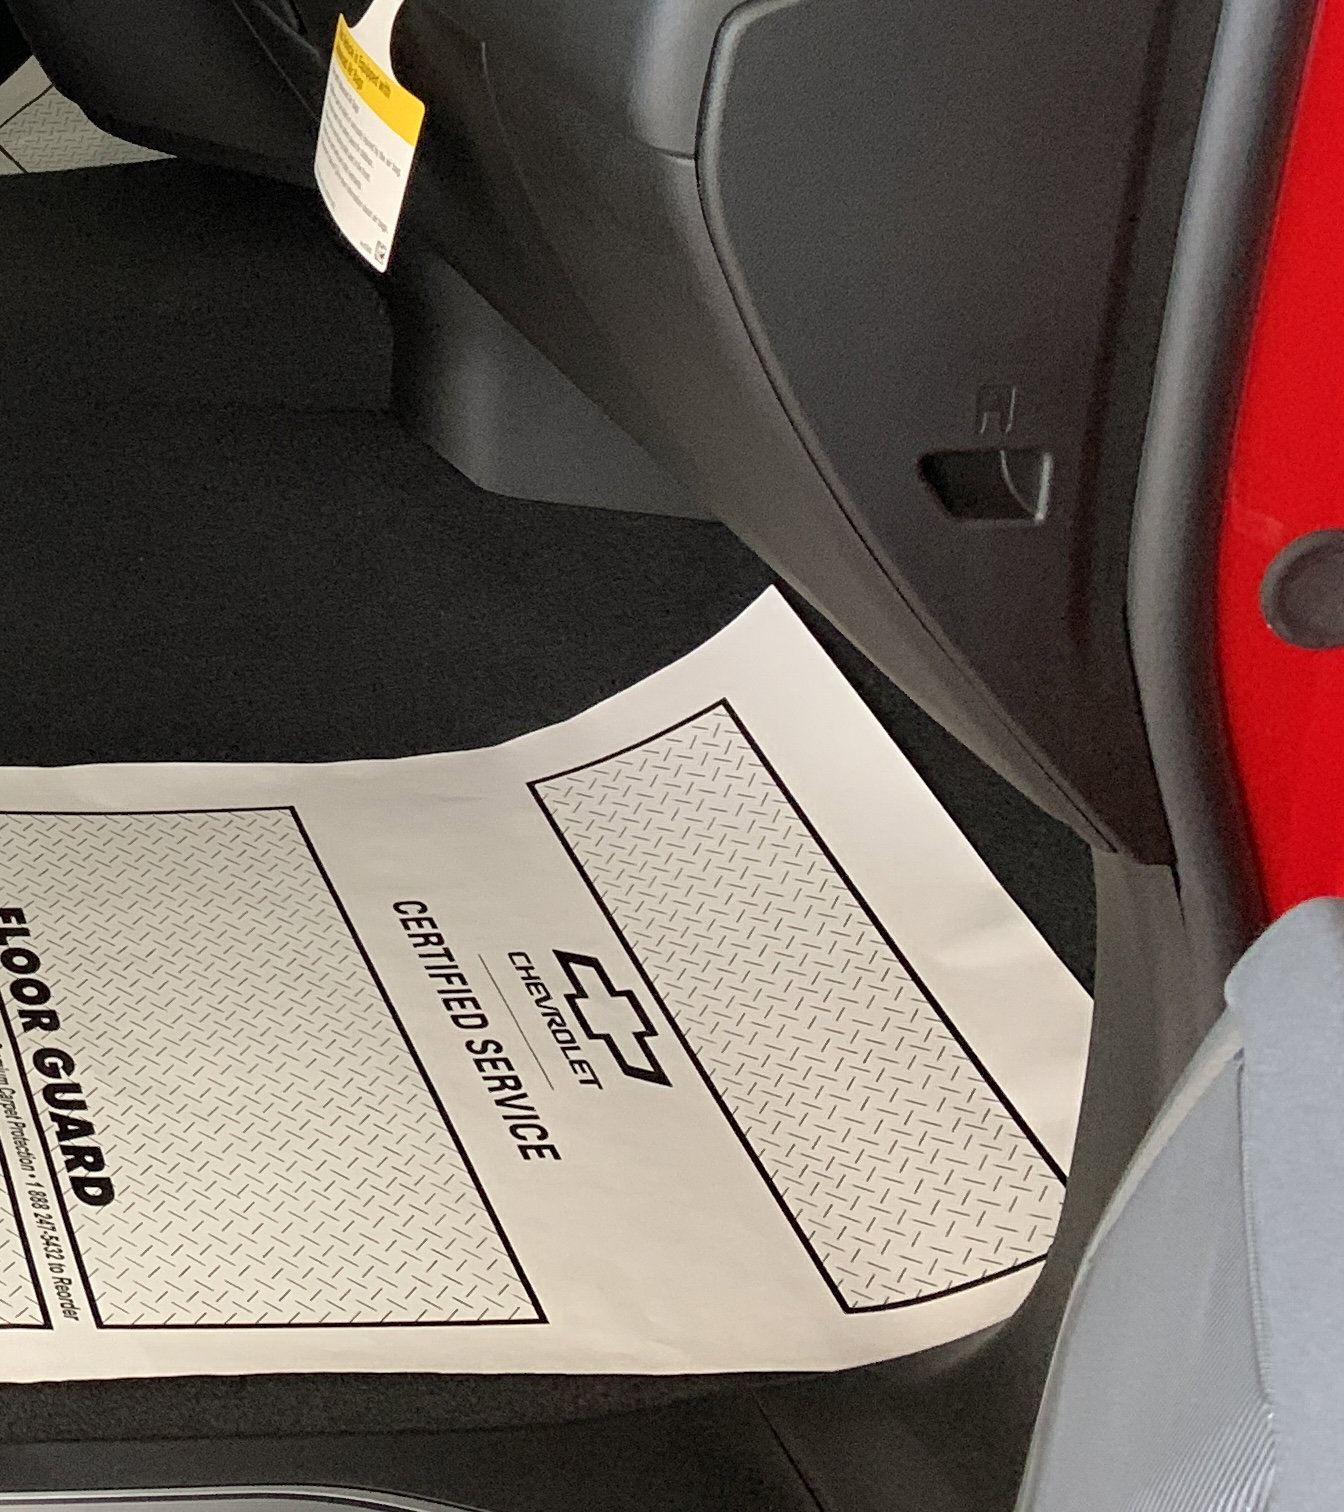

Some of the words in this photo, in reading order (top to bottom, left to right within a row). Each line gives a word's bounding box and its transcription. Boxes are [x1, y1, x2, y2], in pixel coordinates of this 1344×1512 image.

[392, 899, 490, 1030] CERTIFIED
[464, 1039, 562, 1161] SERVICE
[507, 951, 604, 1090] CHEVROLET
[8, 1120, 37, 1173] Protection
[32, 1047, 116, 1207] GUARD
[27, 1190, 50, 1210] 888
[47, 1262, 67, 1273] to
[51, 1275, 81, 1322] Reorder
